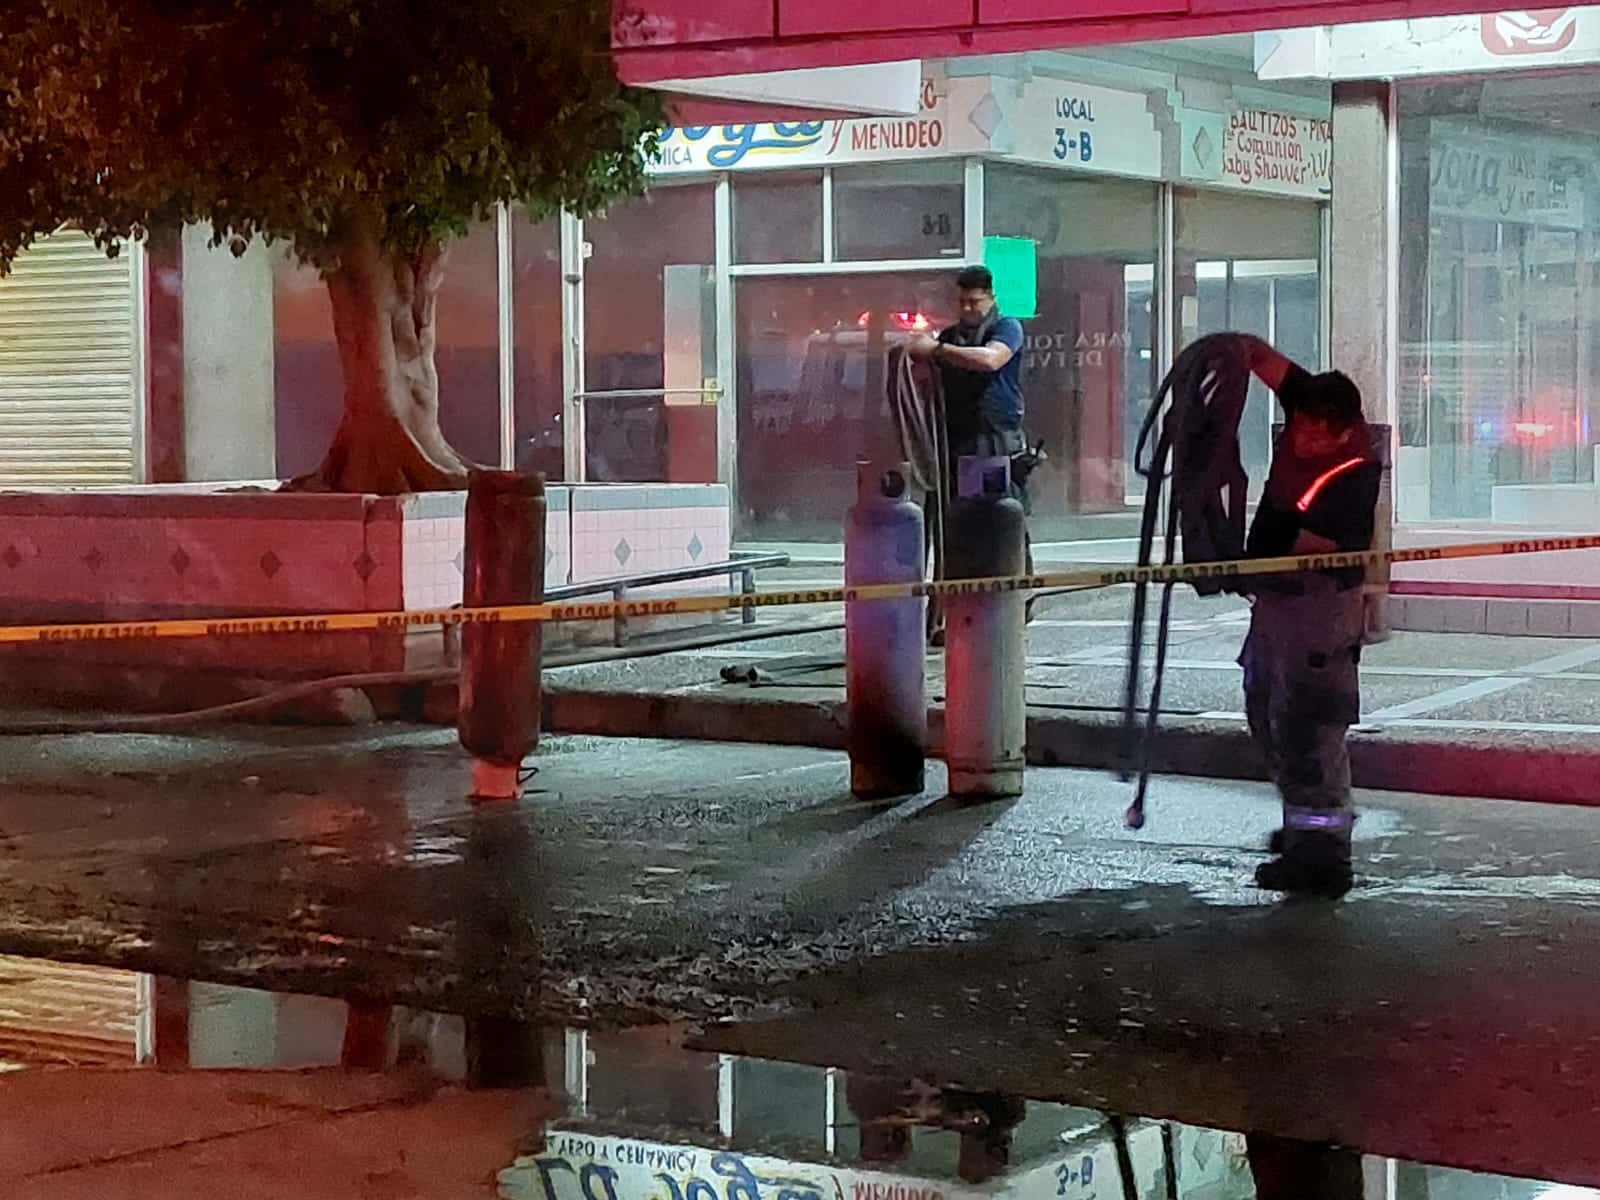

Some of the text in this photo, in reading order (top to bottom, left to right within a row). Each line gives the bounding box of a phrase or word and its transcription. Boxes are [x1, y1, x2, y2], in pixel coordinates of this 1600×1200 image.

[1056, 97, 1095, 122] LOCAL
[852, 119, 942, 151] MENUDEO
[1054, 127, 1092, 162] 3-B
